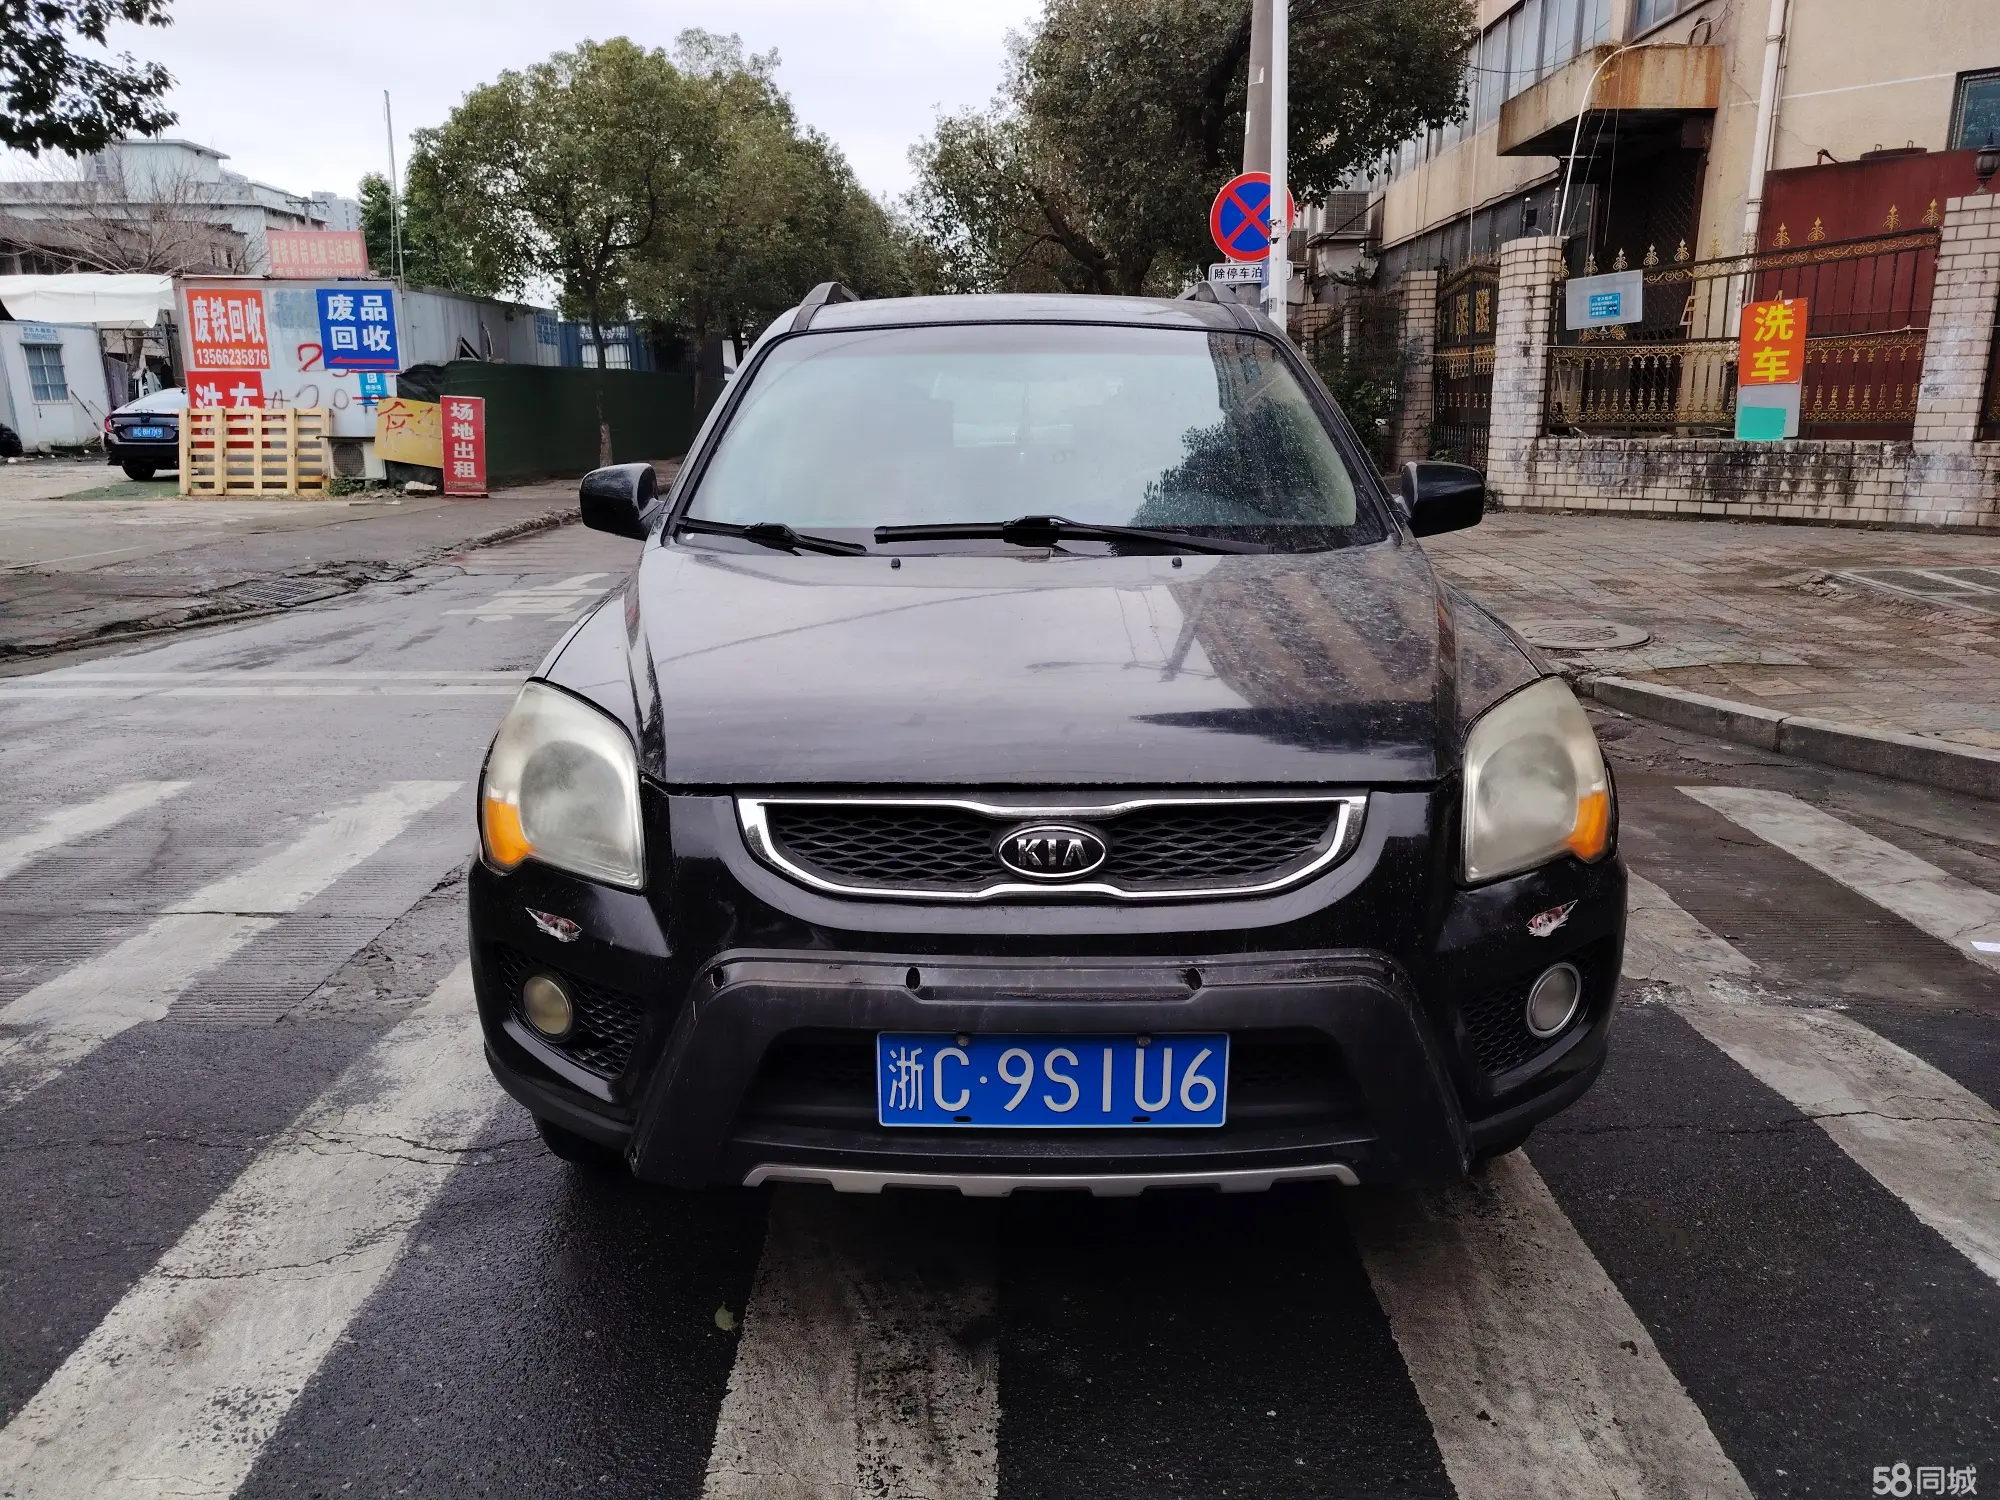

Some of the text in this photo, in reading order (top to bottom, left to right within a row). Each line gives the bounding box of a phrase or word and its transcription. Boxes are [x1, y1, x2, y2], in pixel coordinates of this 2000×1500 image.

[193, 296, 264, 343] 废铁回收
[327, 294, 388, 321] 废品
[330, 325, 392, 351] 回收
[1751, 304, 1794, 383] 洗车
[197, 348, 268, 366] 13566235876
[450, 402, 476, 478] 场地出租
[1016, 838, 1091, 866] KIA
